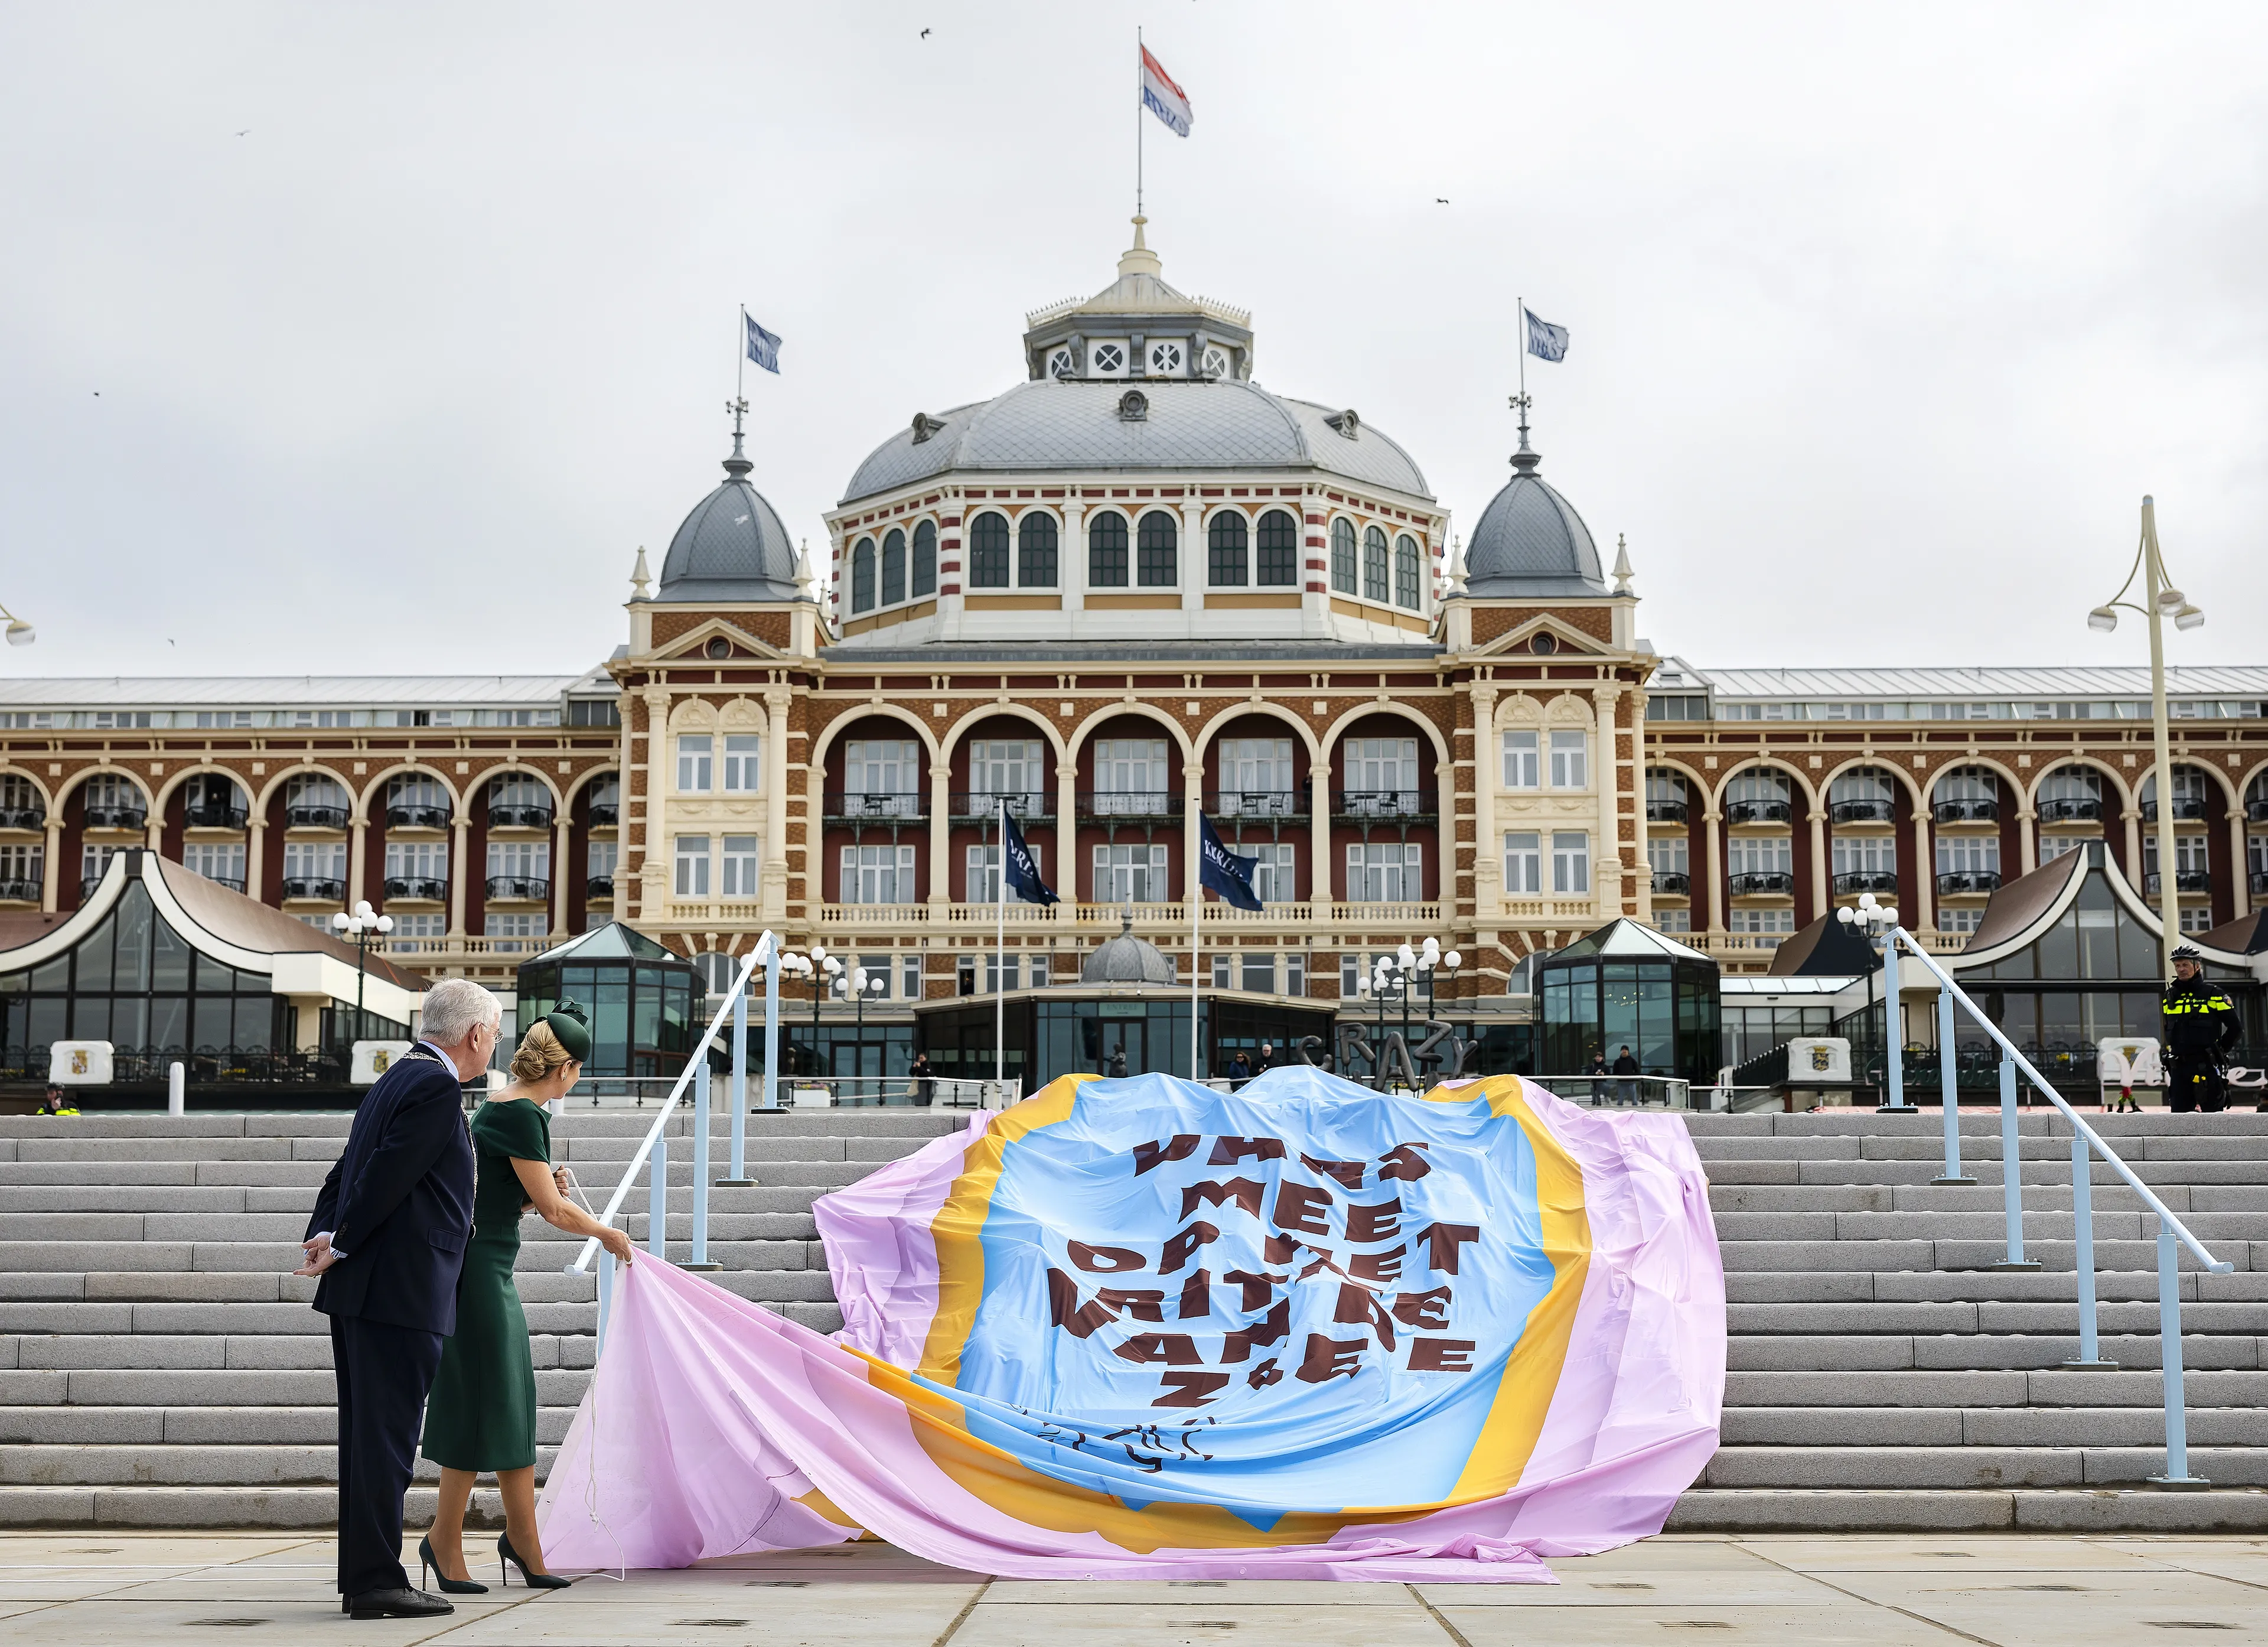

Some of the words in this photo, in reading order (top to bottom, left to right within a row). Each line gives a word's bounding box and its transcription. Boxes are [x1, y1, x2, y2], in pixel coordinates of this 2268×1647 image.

[1297, 1020, 1478, 1092] CRAZY
[1177, 1176, 1403, 1242] MEE
[1067, 1220, 1220, 1275] OP
